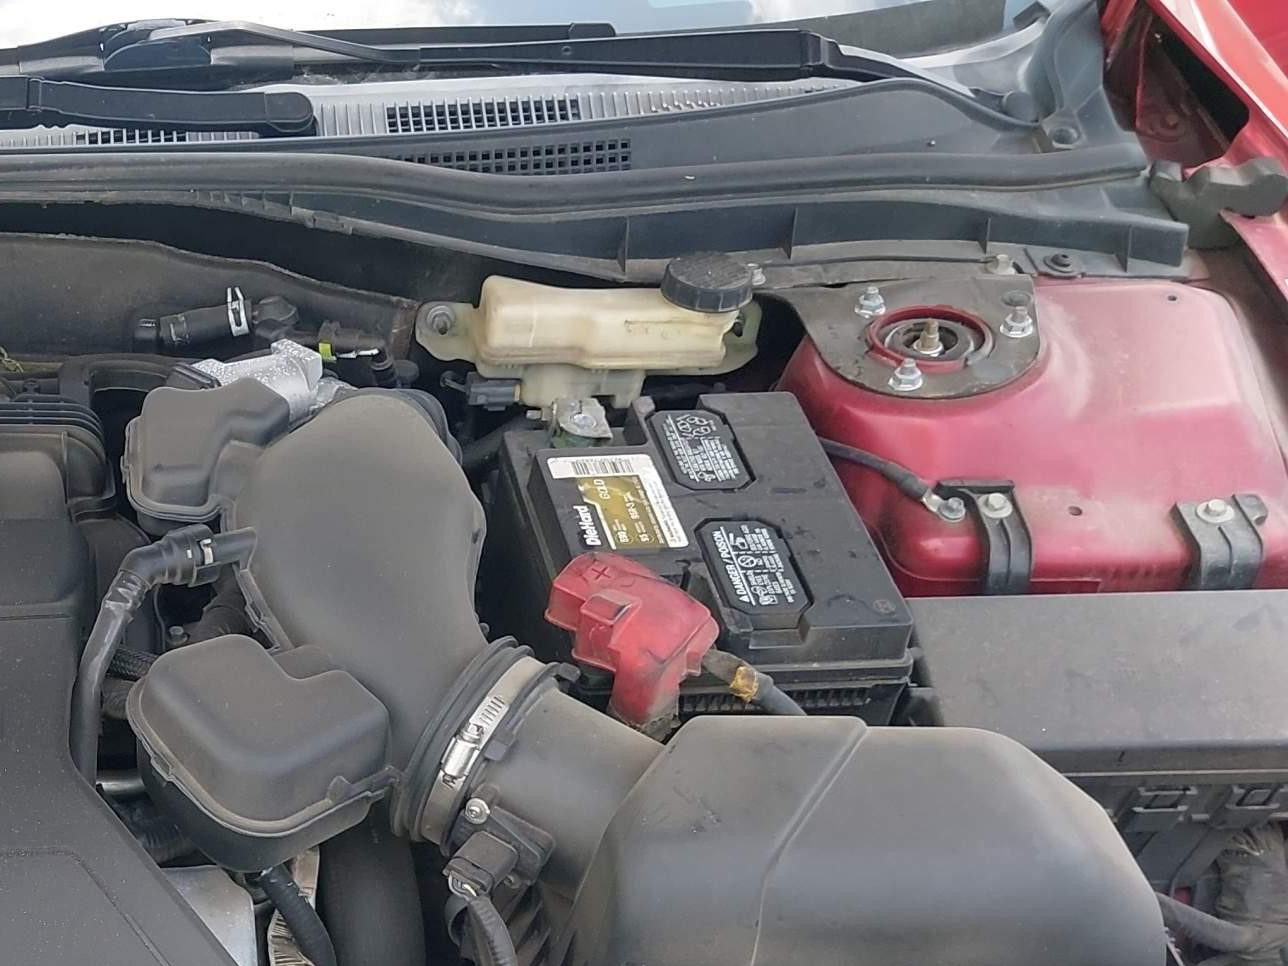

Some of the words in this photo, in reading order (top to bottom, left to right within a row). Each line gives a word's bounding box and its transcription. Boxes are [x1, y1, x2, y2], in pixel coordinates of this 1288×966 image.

[593, 479, 611, 500] GOLD
[573, 504, 602, 546] DieHard
[712, 530, 731, 559] POISON
[725, 564, 747, 595] DANGER
